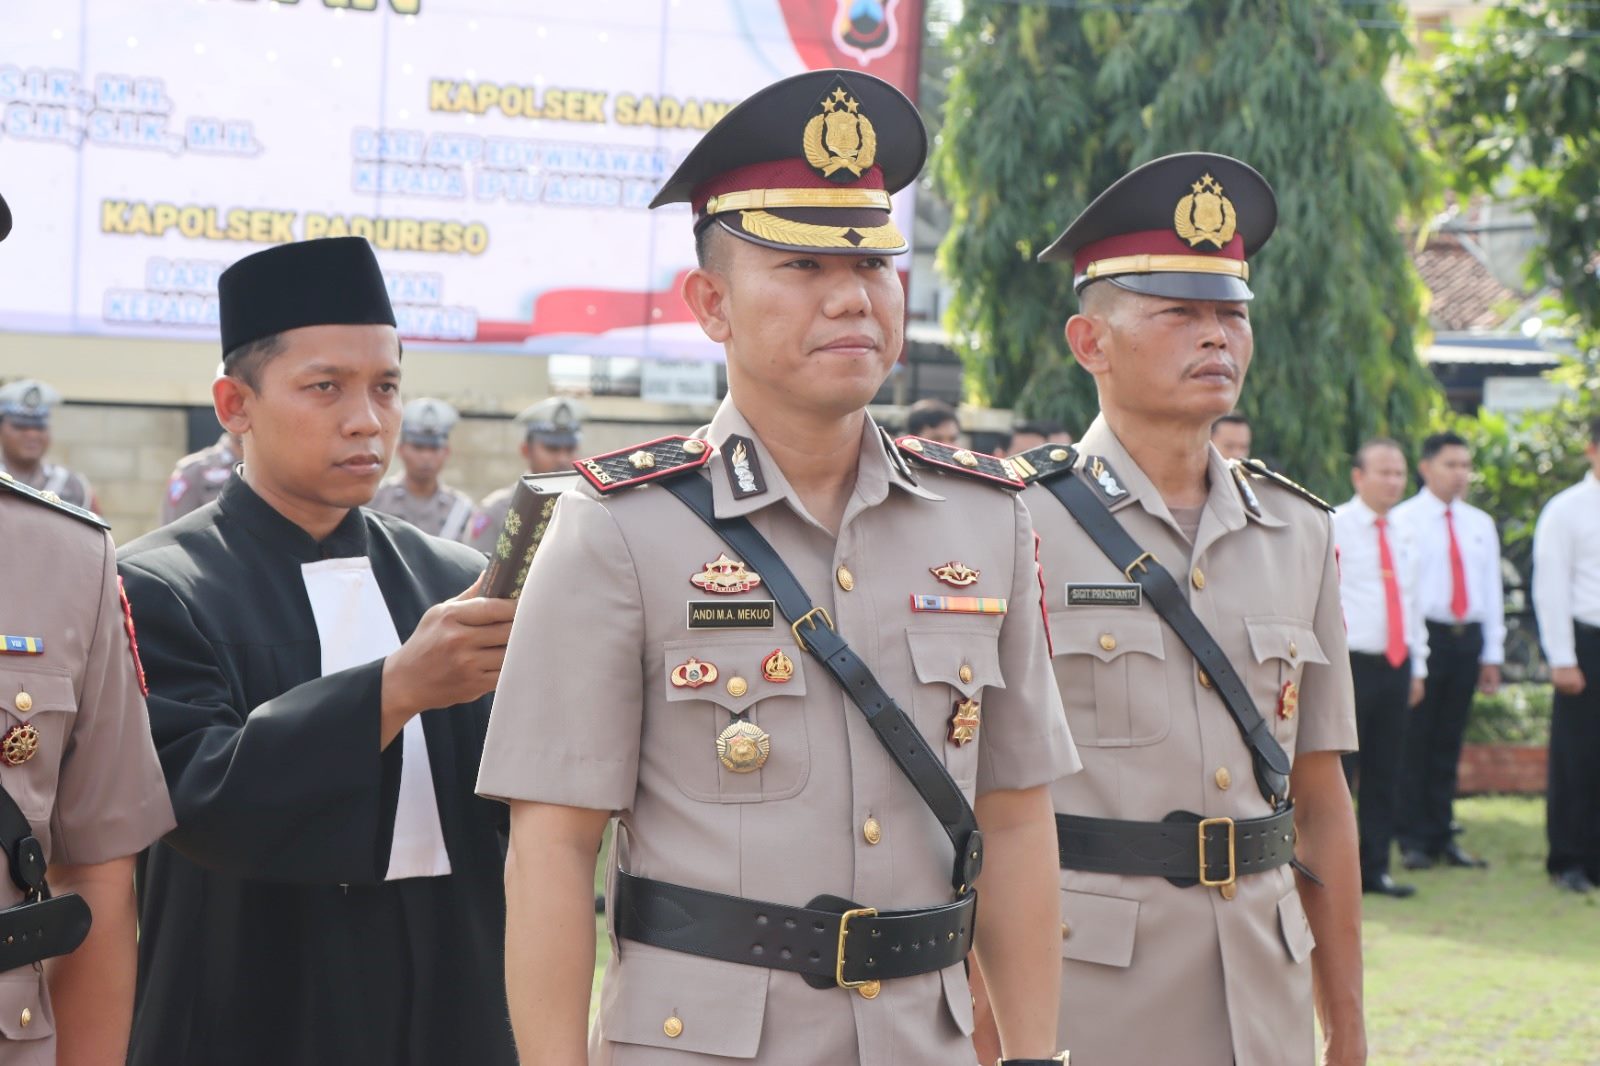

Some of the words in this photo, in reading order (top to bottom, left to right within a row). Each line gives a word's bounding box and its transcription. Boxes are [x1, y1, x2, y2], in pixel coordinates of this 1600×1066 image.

[428, 79, 607, 122] KAPOLSEK
[614, 93, 737, 131] SADAN
[355, 132, 422, 157] DARI
[427, 136, 483, 161] AKP
[356, 166, 463, 193] KEPADA
[477, 173, 543, 199] IPTU
[544, 176, 621, 203] AGUS
[101, 199, 297, 243] KAPOLSEK
[303, 213, 489, 255] PADURESO
[582, 459, 616, 484] POLISI
[1072, 588, 1090, 600] SIGIT
[692, 608, 715, 621] ANDI
[716, 608, 736, 621] M.A.
[737, 608, 771, 621] MEKUO
